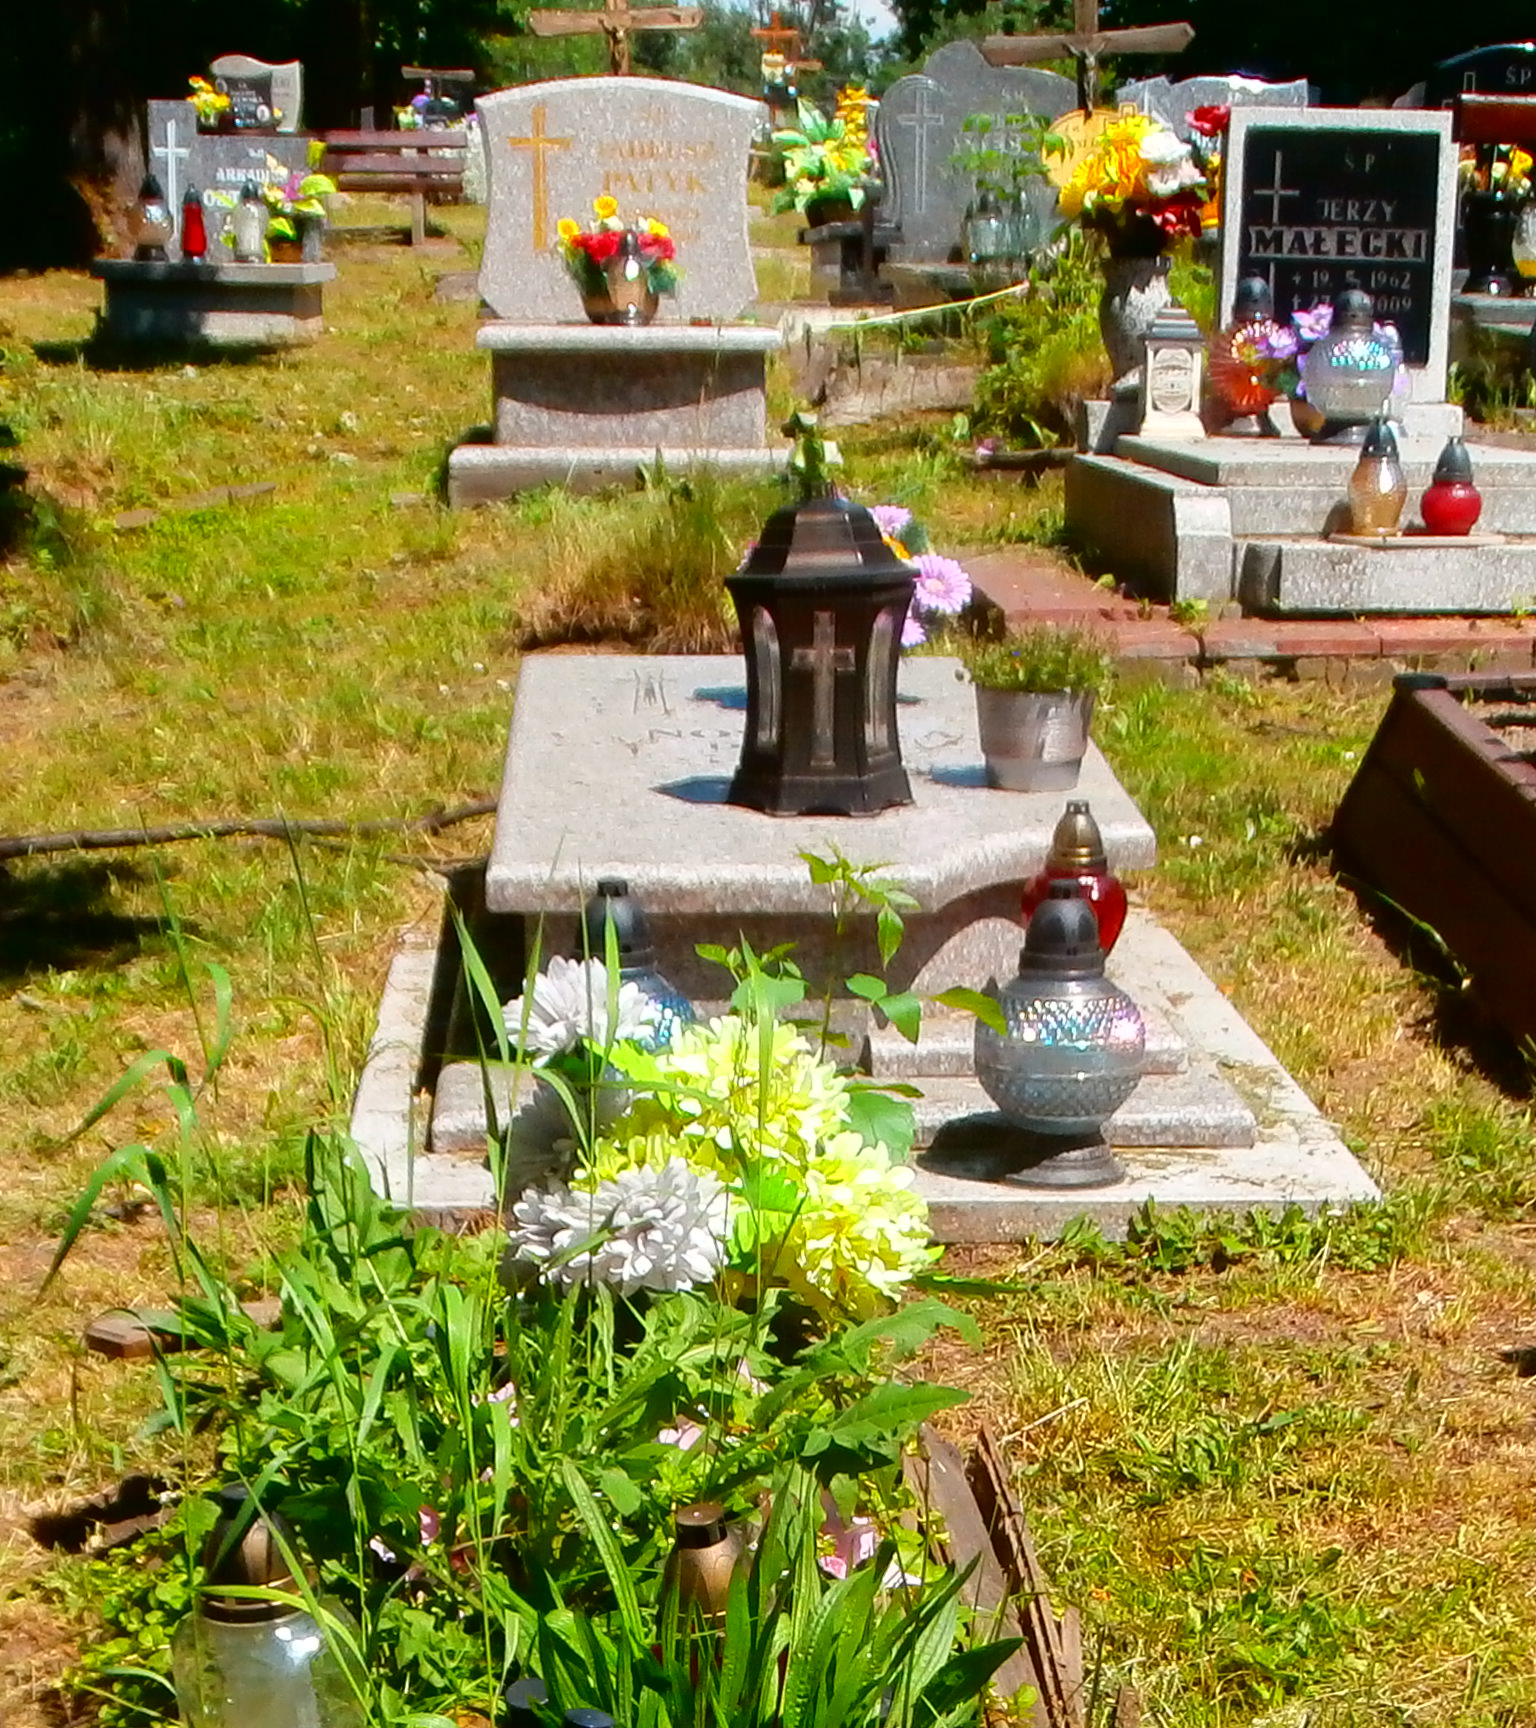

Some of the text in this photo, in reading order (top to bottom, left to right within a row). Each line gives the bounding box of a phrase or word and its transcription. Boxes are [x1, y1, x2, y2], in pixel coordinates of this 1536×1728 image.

[1316, 199, 1397, 223] JERZY
[1249, 226, 1427, 262] MAŁECKI
[1369, 295, 1412, 313] 009
